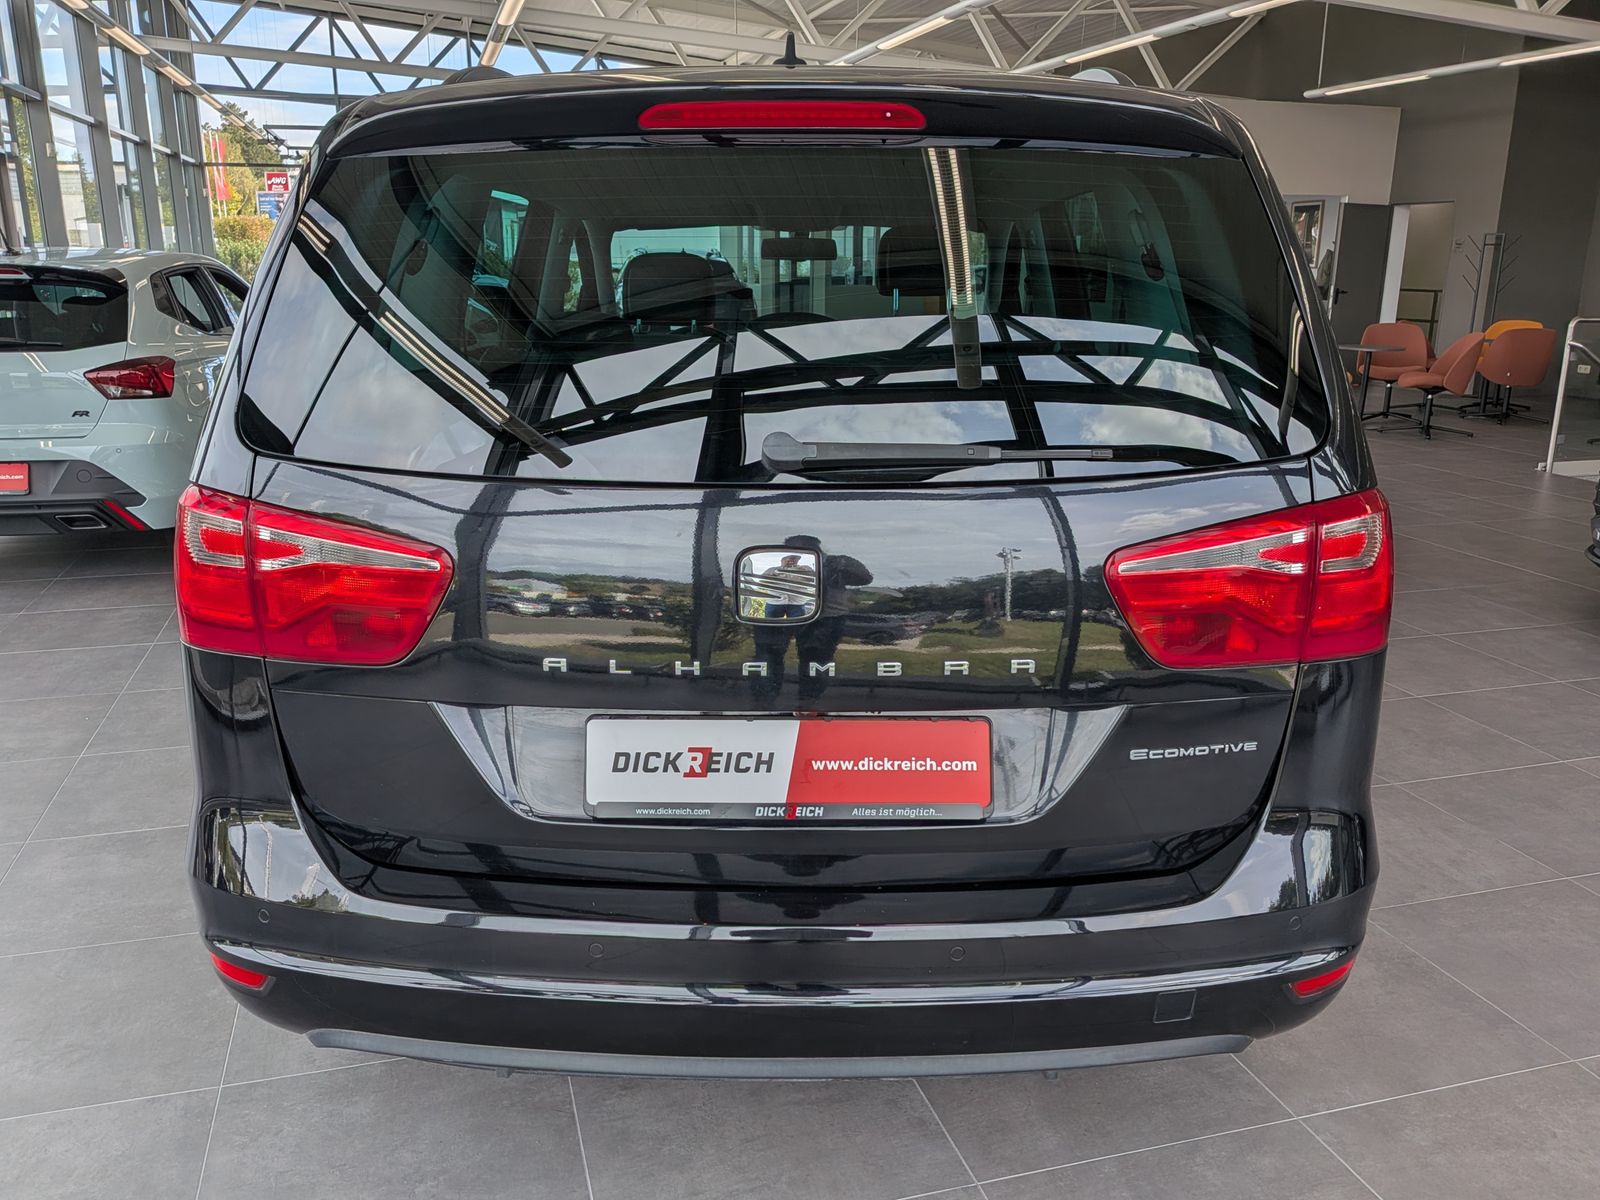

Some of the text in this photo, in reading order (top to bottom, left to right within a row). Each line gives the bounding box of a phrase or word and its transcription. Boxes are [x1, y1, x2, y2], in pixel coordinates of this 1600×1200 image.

[71, 410, 90, 418] FR
[542, 657, 1036, 677] ALHAMBRA
[1129, 741, 1258, 761] ECOMOTIVE
[611, 748, 775, 776] DICKREICH
[811, 756, 978, 772] www.dickreich.com
[635, 806, 711, 816] www.dickreich.com
[851, 807, 943, 818] Alles ist möglich...
